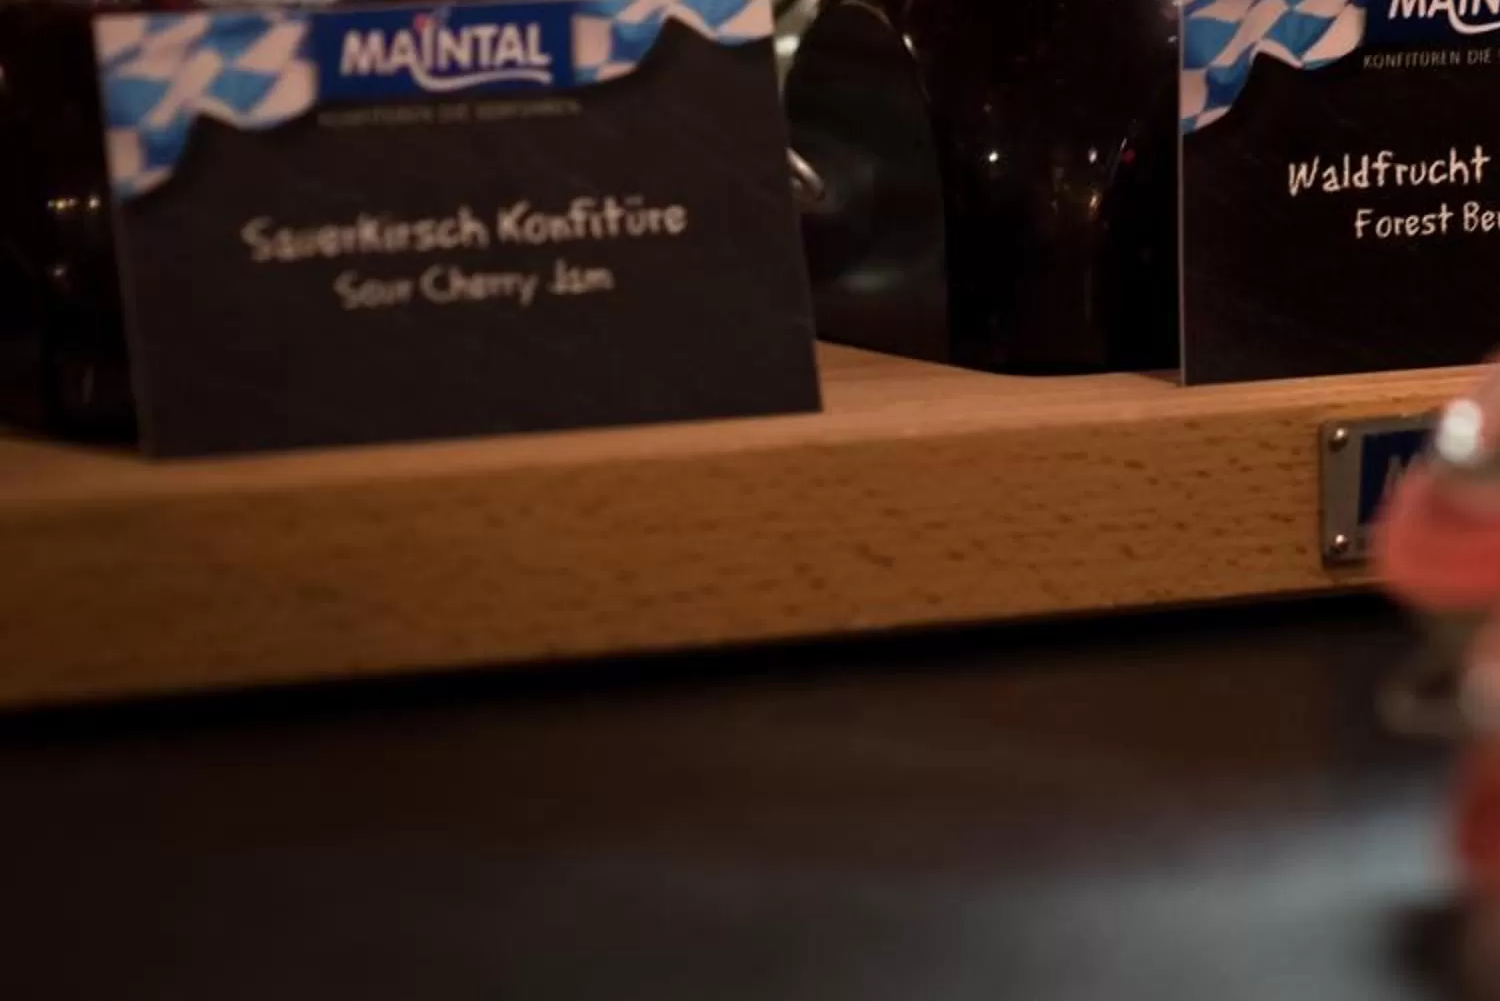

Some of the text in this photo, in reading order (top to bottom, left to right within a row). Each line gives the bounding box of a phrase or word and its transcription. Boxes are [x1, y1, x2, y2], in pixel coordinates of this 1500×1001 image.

[339, 12, 552, 92] MAINTAL
[1466, 47, 1492, 65] DIE
[1287, 144, 1491, 197] Waldfrucht
[498, 196, 688, 247] Konfitüre
[1354, 202, 1454, 239] Forest
[334, 259, 615, 310] Sour Cherry Jam
